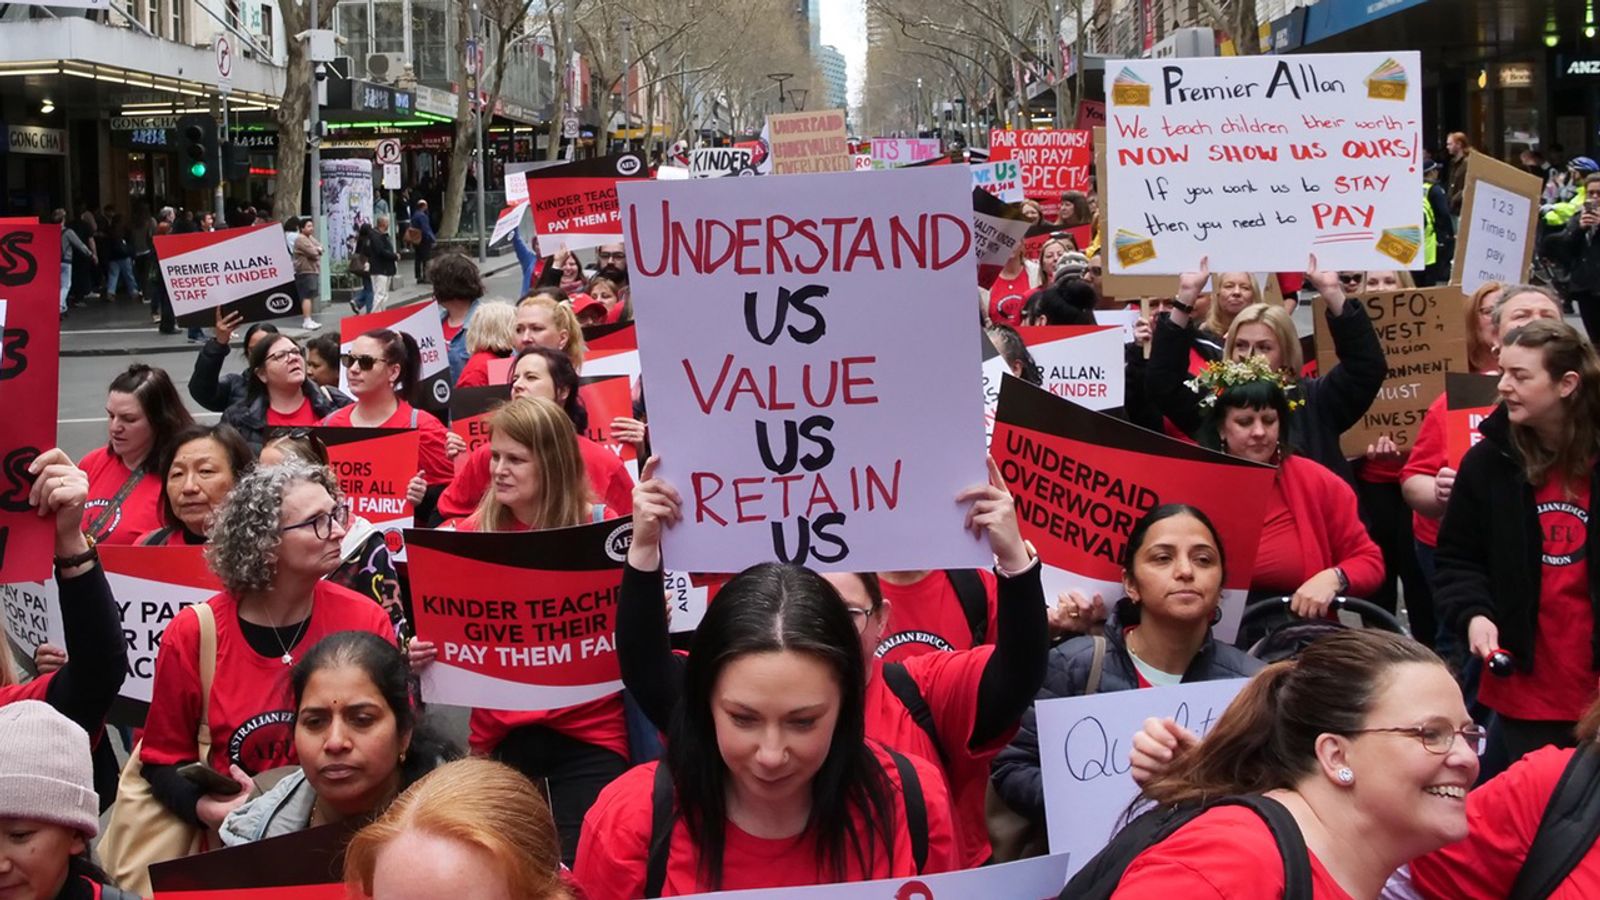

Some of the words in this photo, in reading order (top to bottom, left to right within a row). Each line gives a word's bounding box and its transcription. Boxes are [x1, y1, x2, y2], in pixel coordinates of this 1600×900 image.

[1567, 60, 1600, 74] ANZ
[1162, 66, 1258, 105] Premier
[1265, 60, 1345, 101] Allan
[773, 115, 843, 134] UNDERPAID
[1114, 114, 1149, 138] We
[1162, 115, 1212, 137] teach
[1221, 113, 1288, 135] children
[1301, 115, 1345, 130] their
[10, 131, 38, 149] GONG
[40, 133, 59, 150] CHA
[873, 140, 899, 160] ITS
[991, 130, 1018, 147] FAIR
[1021, 131, 1089, 148] CONDITIONS!
[693, 150, 750, 172] KINDER
[1011, 148, 1038, 164] FAIR
[1041, 148, 1073, 164] PAY!
[1118, 143, 1188, 166] NOW
[1208, 142, 1278, 164] SHOW
[1289, 142, 1327, 161] US
[1342, 131, 1418, 173] OURS!
[1021, 165, 1089, 189] SPECT!!
[536, 194, 581, 212] KINDER
[584, 188, 618, 202] TEAC
[1145, 176, 1169, 201] If
[1184, 186, 1213, 205] you
[1223, 179, 1258, 194] want
[1271, 183, 1290, 194] us
[1302, 177, 1320, 193] to
[1334, 175, 1391, 194] STAY
[557, 205, 585, 218] GIVE
[1144, 212, 1189, 237] then
[1197, 220, 1222, 241] you
[1232, 212, 1266, 229] need
[1276, 211, 1297, 225] to
[1311, 202, 1375, 230] PAY
[548, 219, 570, 233] PAY
[572, 214, 607, 227] THEM
[1481, 218, 1505, 238] Time
[1506, 230, 1517, 242] to
[630, 200, 972, 277] UNDERSTAND
[167, 262, 219, 276] PREMIER
[223, 255, 273, 272] ALLAN:
[1486, 248, 1505, 264] pay
[170, 275, 220, 289] RESPECT
[225, 267, 278, 284] KINDER
[173, 289, 208, 301] STAFF
[744, 285, 829, 345] US
[1376, 321, 1426, 341] VEST
[1386, 343, 1431, 356] lusion
[1049, 366, 1105, 380] ALLAN:
[1384, 358, 1452, 380] RNMENT
[682, 354, 879, 415] VALUE
[1049, 383, 1107, 397] KINDER
[1364, 408, 1430, 428] INVEST
[589, 428, 608, 442] LL
[755, 415, 835, 475] US
[1007, 430, 1160, 512] UNDERPAID
[340, 480, 364, 494] EIR
[368, 480, 395, 495] ALL
[691, 459, 902, 527] RETAIN
[1001, 459, 1136, 537] OVERWOR
[359, 497, 407, 514] FAIRLY
[1561, 502, 1589, 524] EDUCA
[771, 512, 849, 567] US
[1010, 491, 1128, 567] NDERVAL
[1543, 524, 1580, 543] EU
[613, 535, 633, 551] AE
[422, 595, 518, 621] KINDER
[524, 585, 621, 620] TEACH
[677, 577, 688, 612] AND
[7, 617, 48, 648] TEACH
[464, 622, 524, 644] GIVE
[533, 613, 608, 642] THEIR
[444, 641, 488, 665] PAY
[495, 643, 571, 667] THEM
[581, 631, 617, 660] FAI
[873, 632, 914, 658] TRALIAN
[915, 632, 950, 653] EDUCA
[232, 712, 279, 762] AUSTRALIAN
